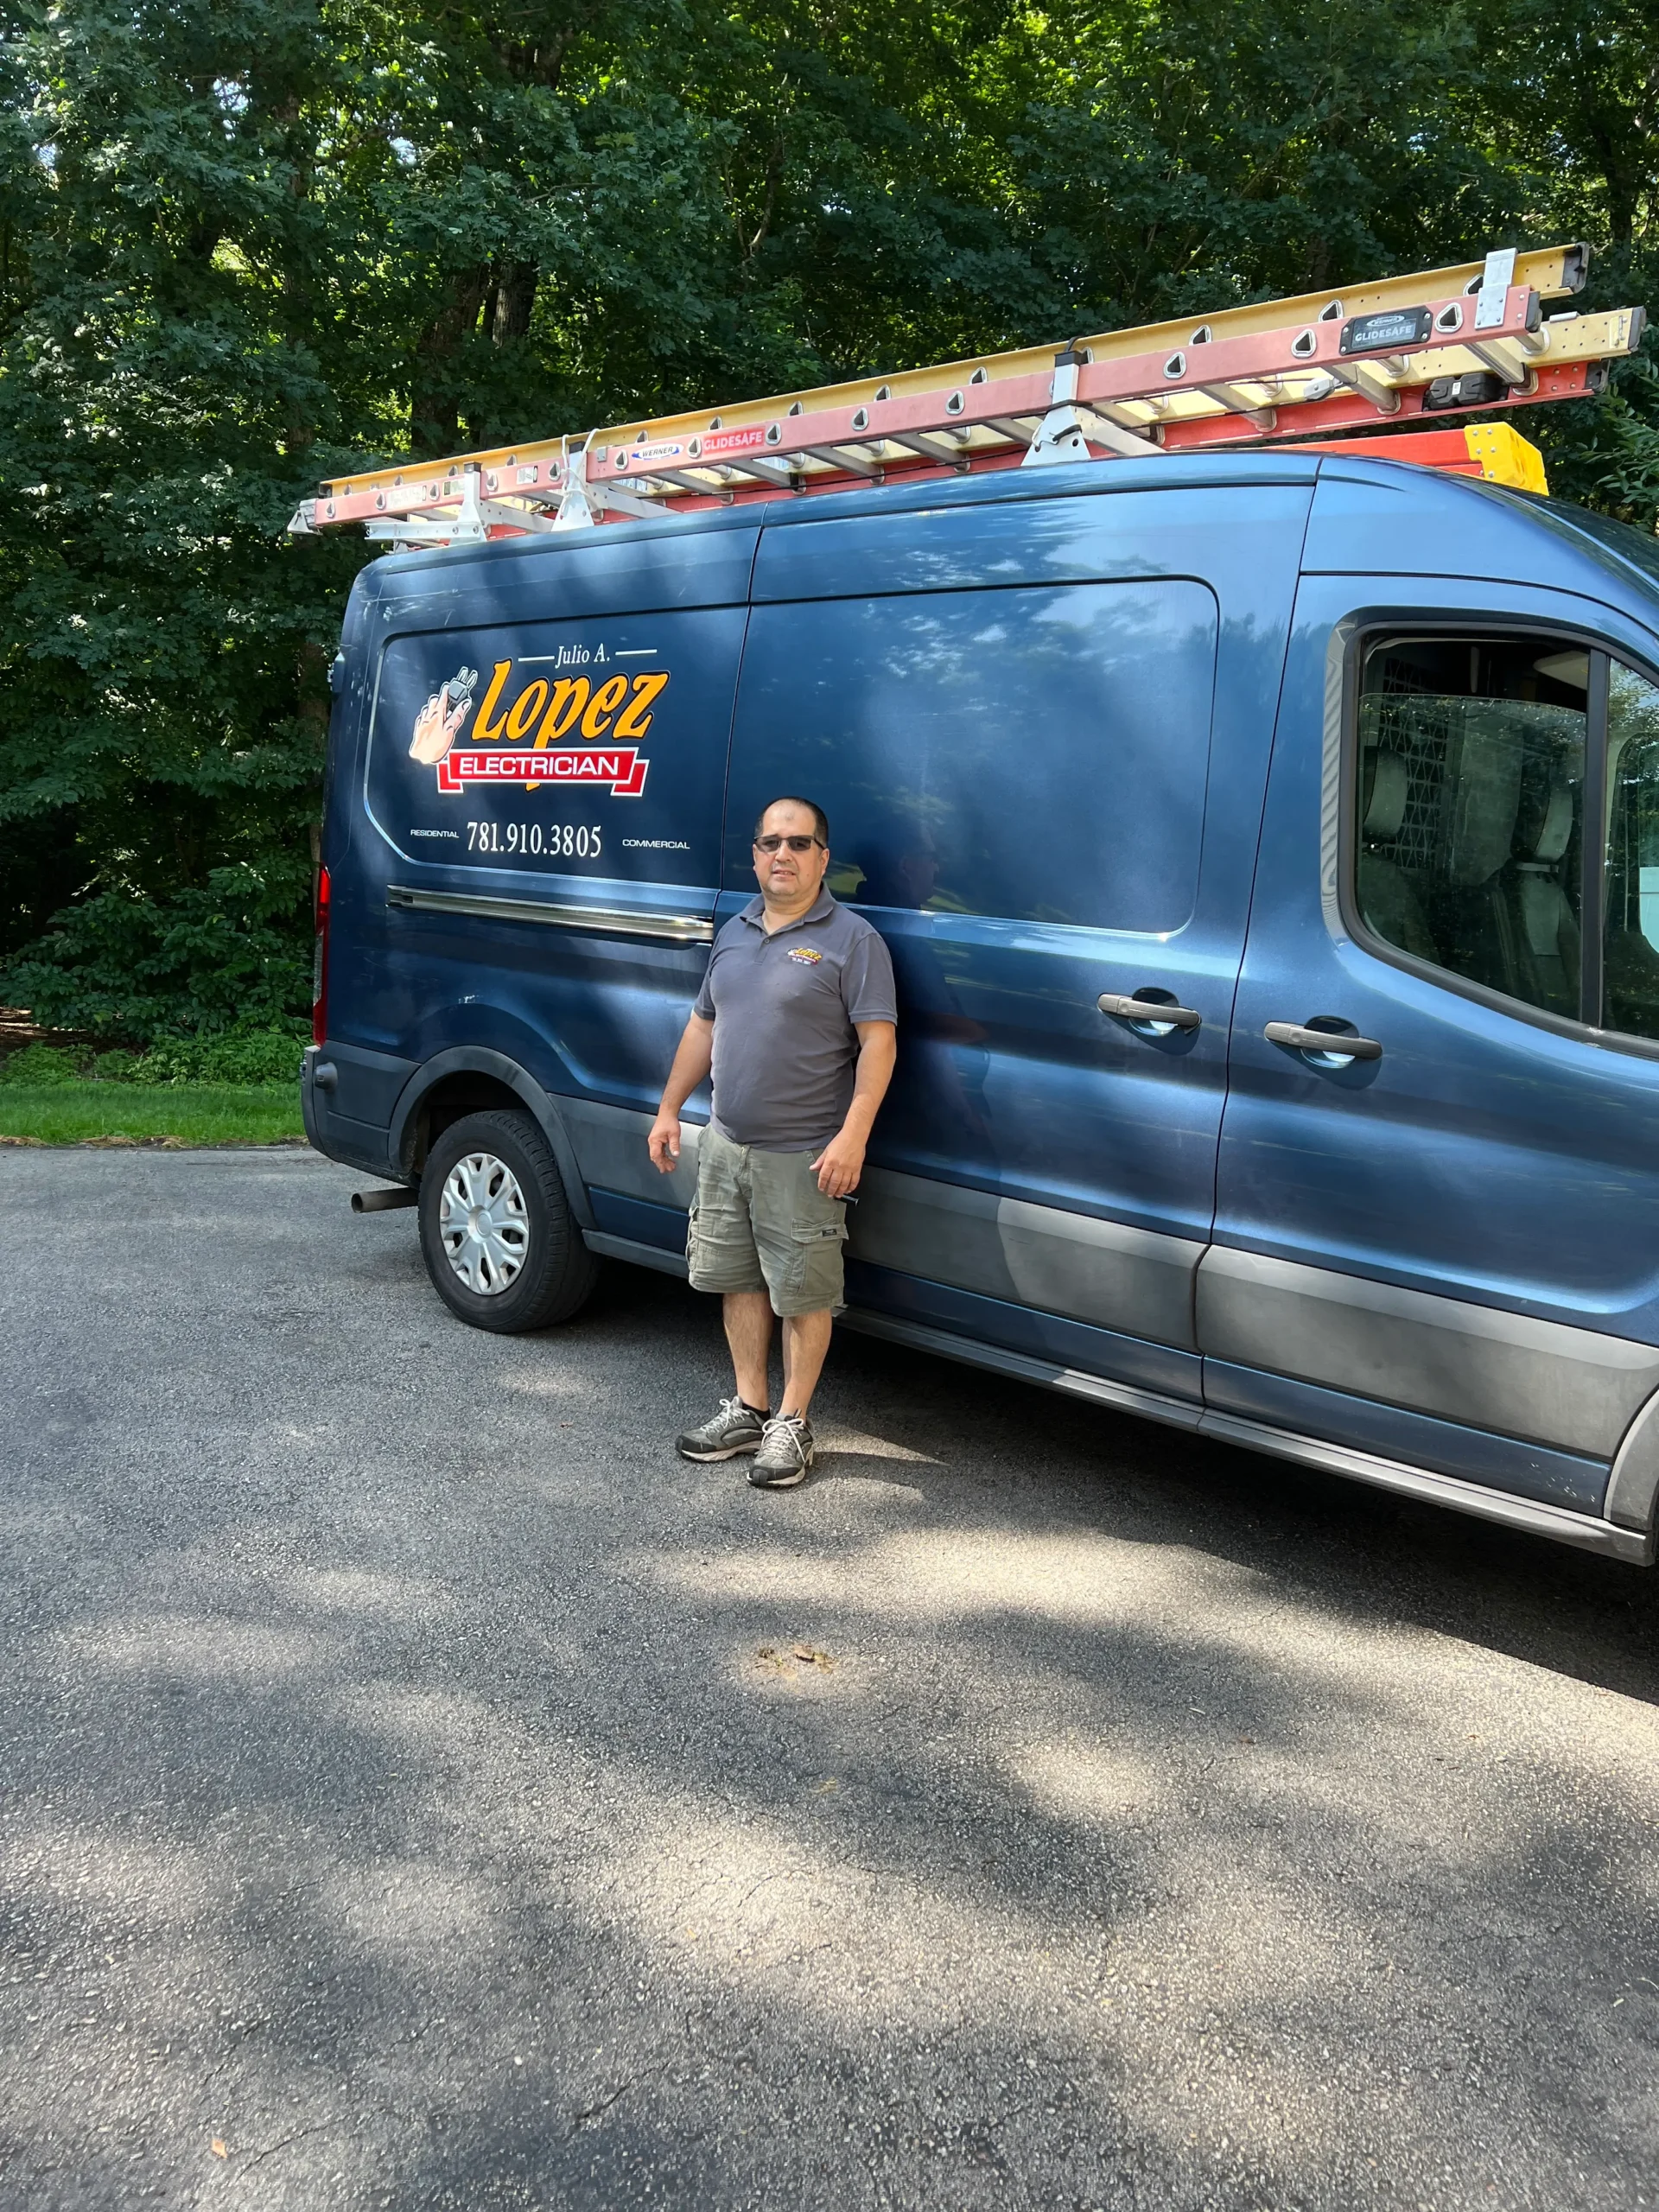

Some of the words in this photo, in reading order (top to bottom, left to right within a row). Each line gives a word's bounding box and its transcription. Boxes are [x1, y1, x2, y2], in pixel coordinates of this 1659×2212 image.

[1355, 325, 1412, 342] GLIDESAFE
[703, 429, 763, 450] GLIDESAFE
[642, 446, 673, 457] WERNER
[555, 644, 590, 669] Julio
[594, 643, 610, 663] A.
[471, 658, 670, 791] Lopez
[459, 756, 620, 776] ELECTRICIAN
[410, 829, 460, 838] RESIDENTIAL
[467, 822, 602, 858] 781.910.3805
[622, 839, 690, 849] COMMERCIAL
